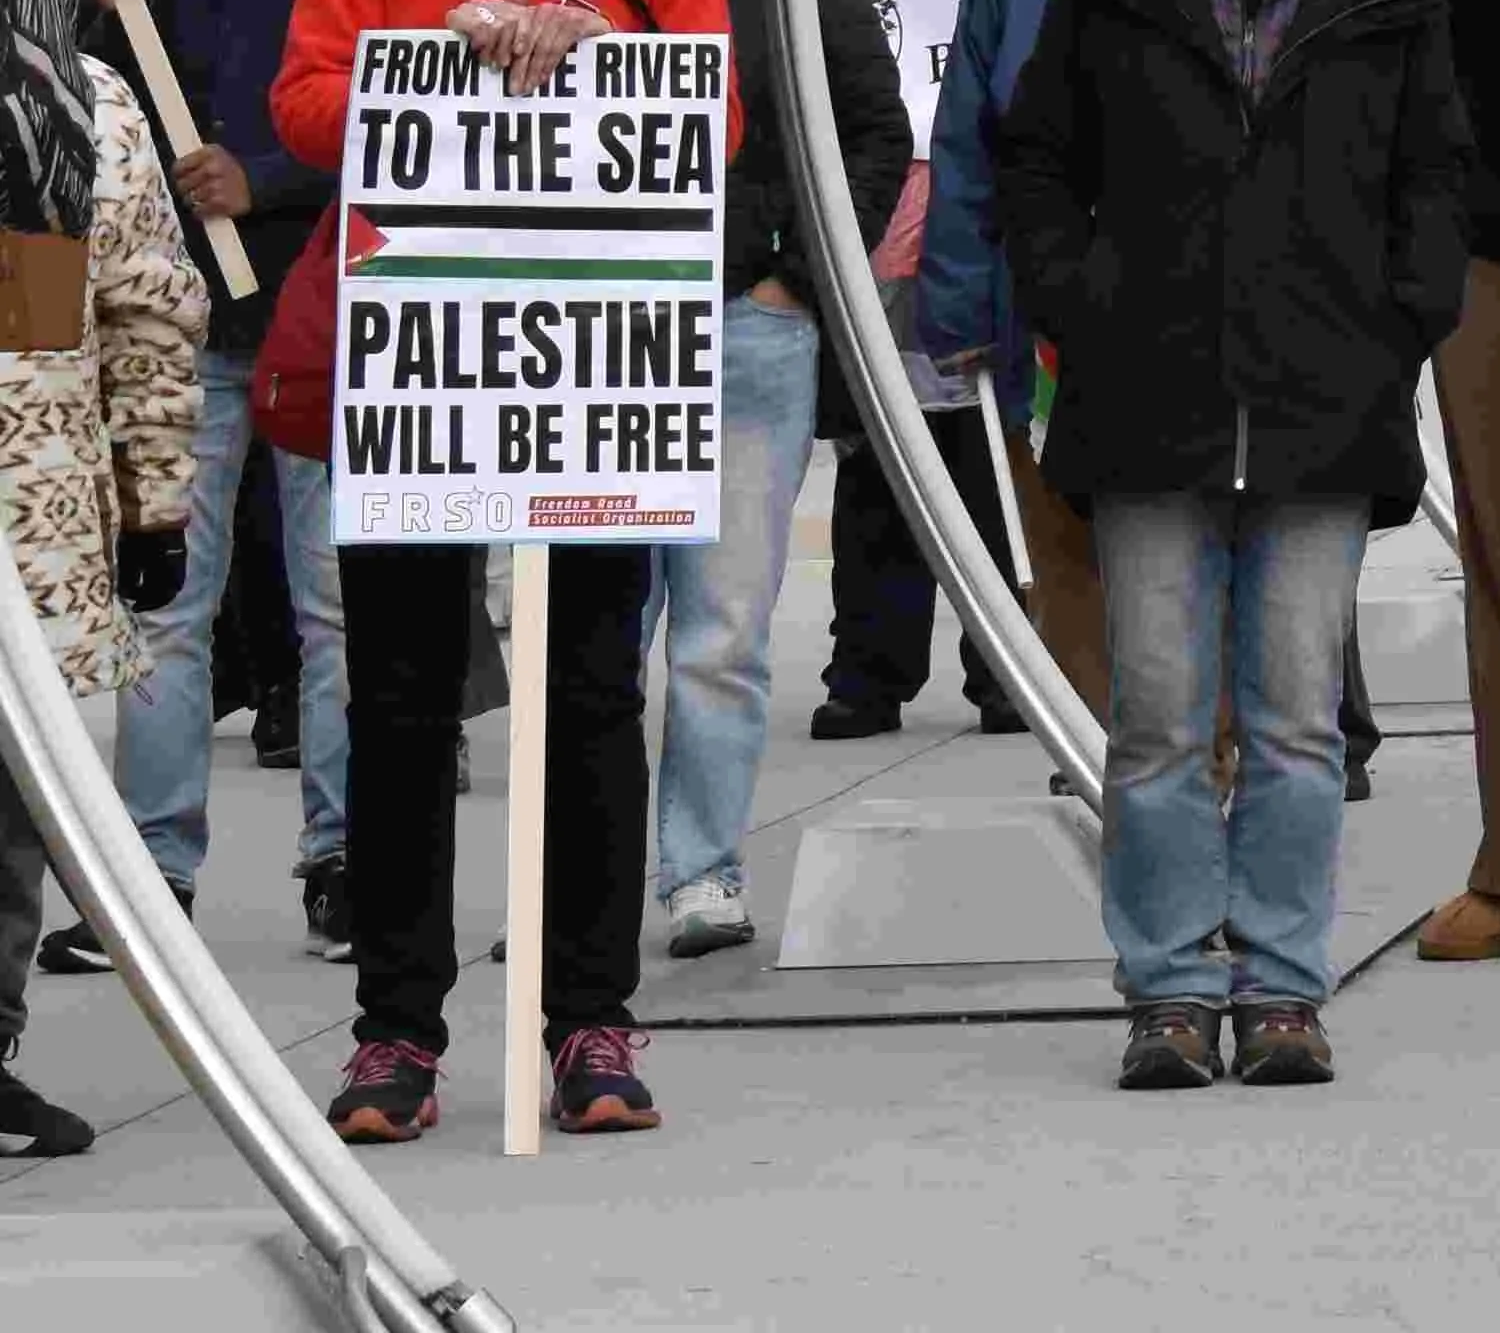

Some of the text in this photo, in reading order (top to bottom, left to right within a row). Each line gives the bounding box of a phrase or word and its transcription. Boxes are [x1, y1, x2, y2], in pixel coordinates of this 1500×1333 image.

[360, 38, 481, 97] FROM
[595, 41, 721, 100] RIVER
[359, 108, 715, 195] TO THE SEA
[348, 300, 714, 391] PALESTINE
[344, 402, 715, 475] WILL BE FREE
[531, 511, 693, 527] Socialist Organization
